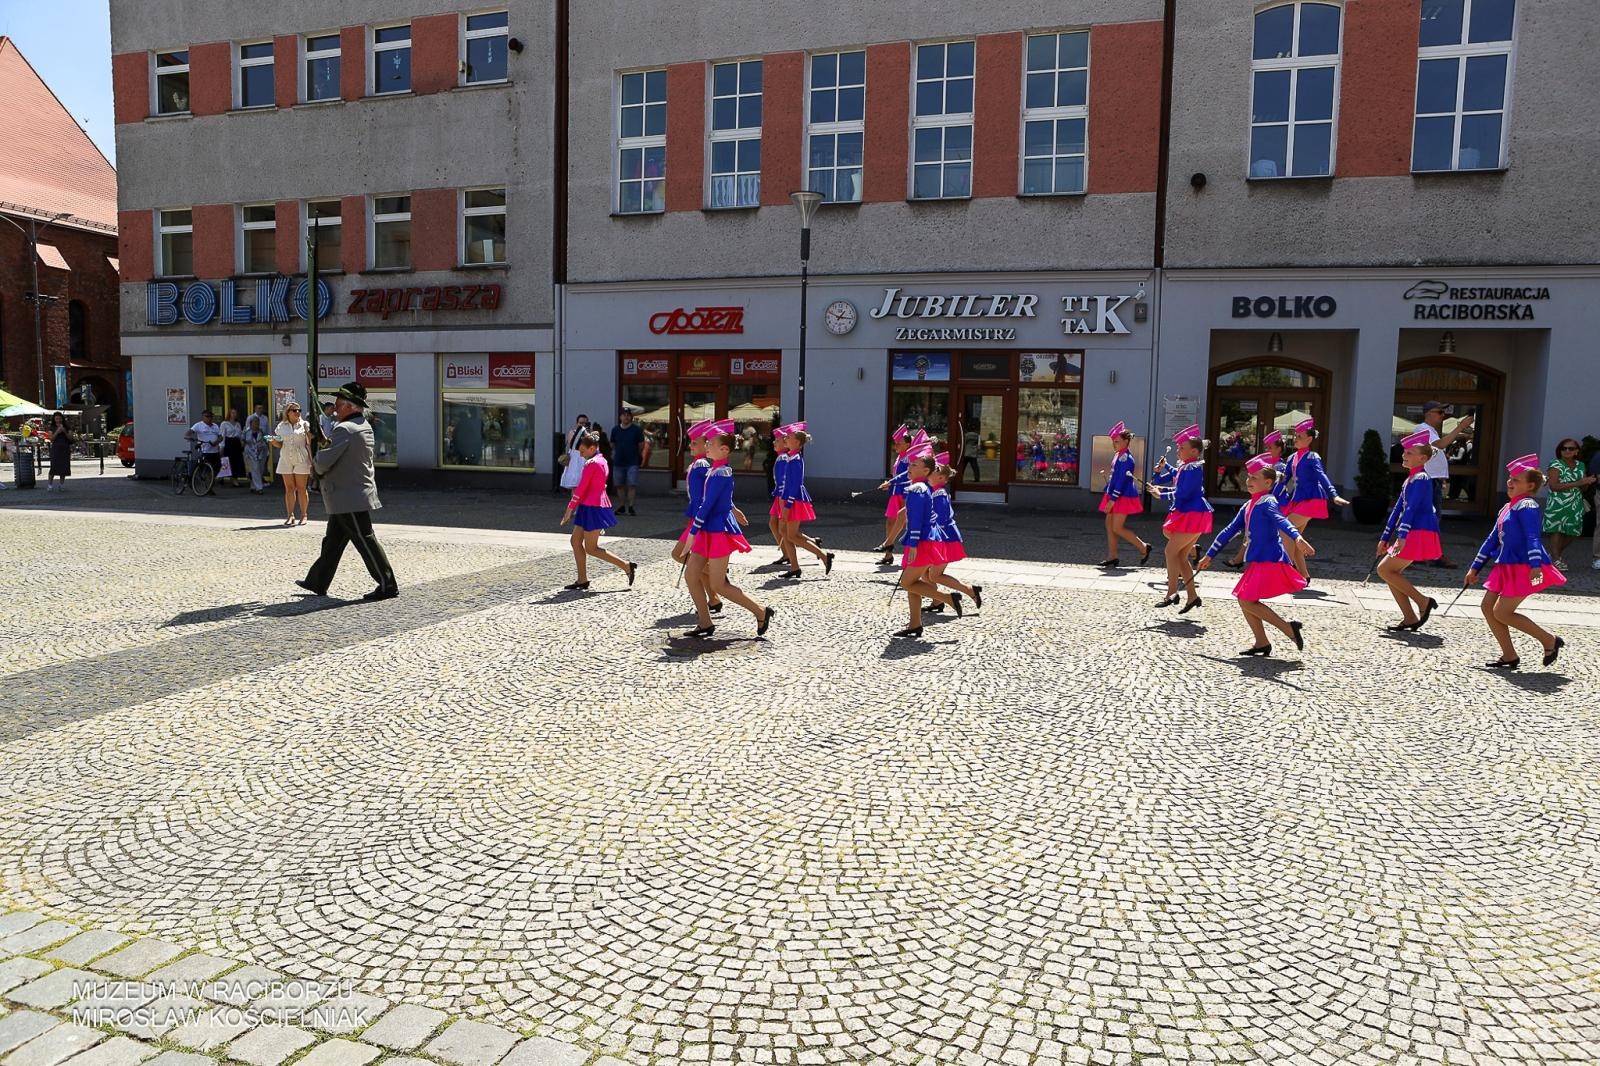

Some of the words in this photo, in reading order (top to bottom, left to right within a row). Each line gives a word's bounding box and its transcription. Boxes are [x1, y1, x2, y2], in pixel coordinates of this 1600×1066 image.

[1450, 287, 1550, 300] RESTAURACJA
[146, 277, 331, 326] BOLKO
[347, 284, 501, 320] zaprasza
[869, 288, 1039, 319] JUBILER
[1231, 295, 1337, 319] BOLKO
[1414, 303, 1535, 320] RACIBORSKA
[895, 327, 1016, 341] ZEGARMISTRZ
[328, 366, 351, 376] Bliski
[457, 366, 483, 376] Bliski
